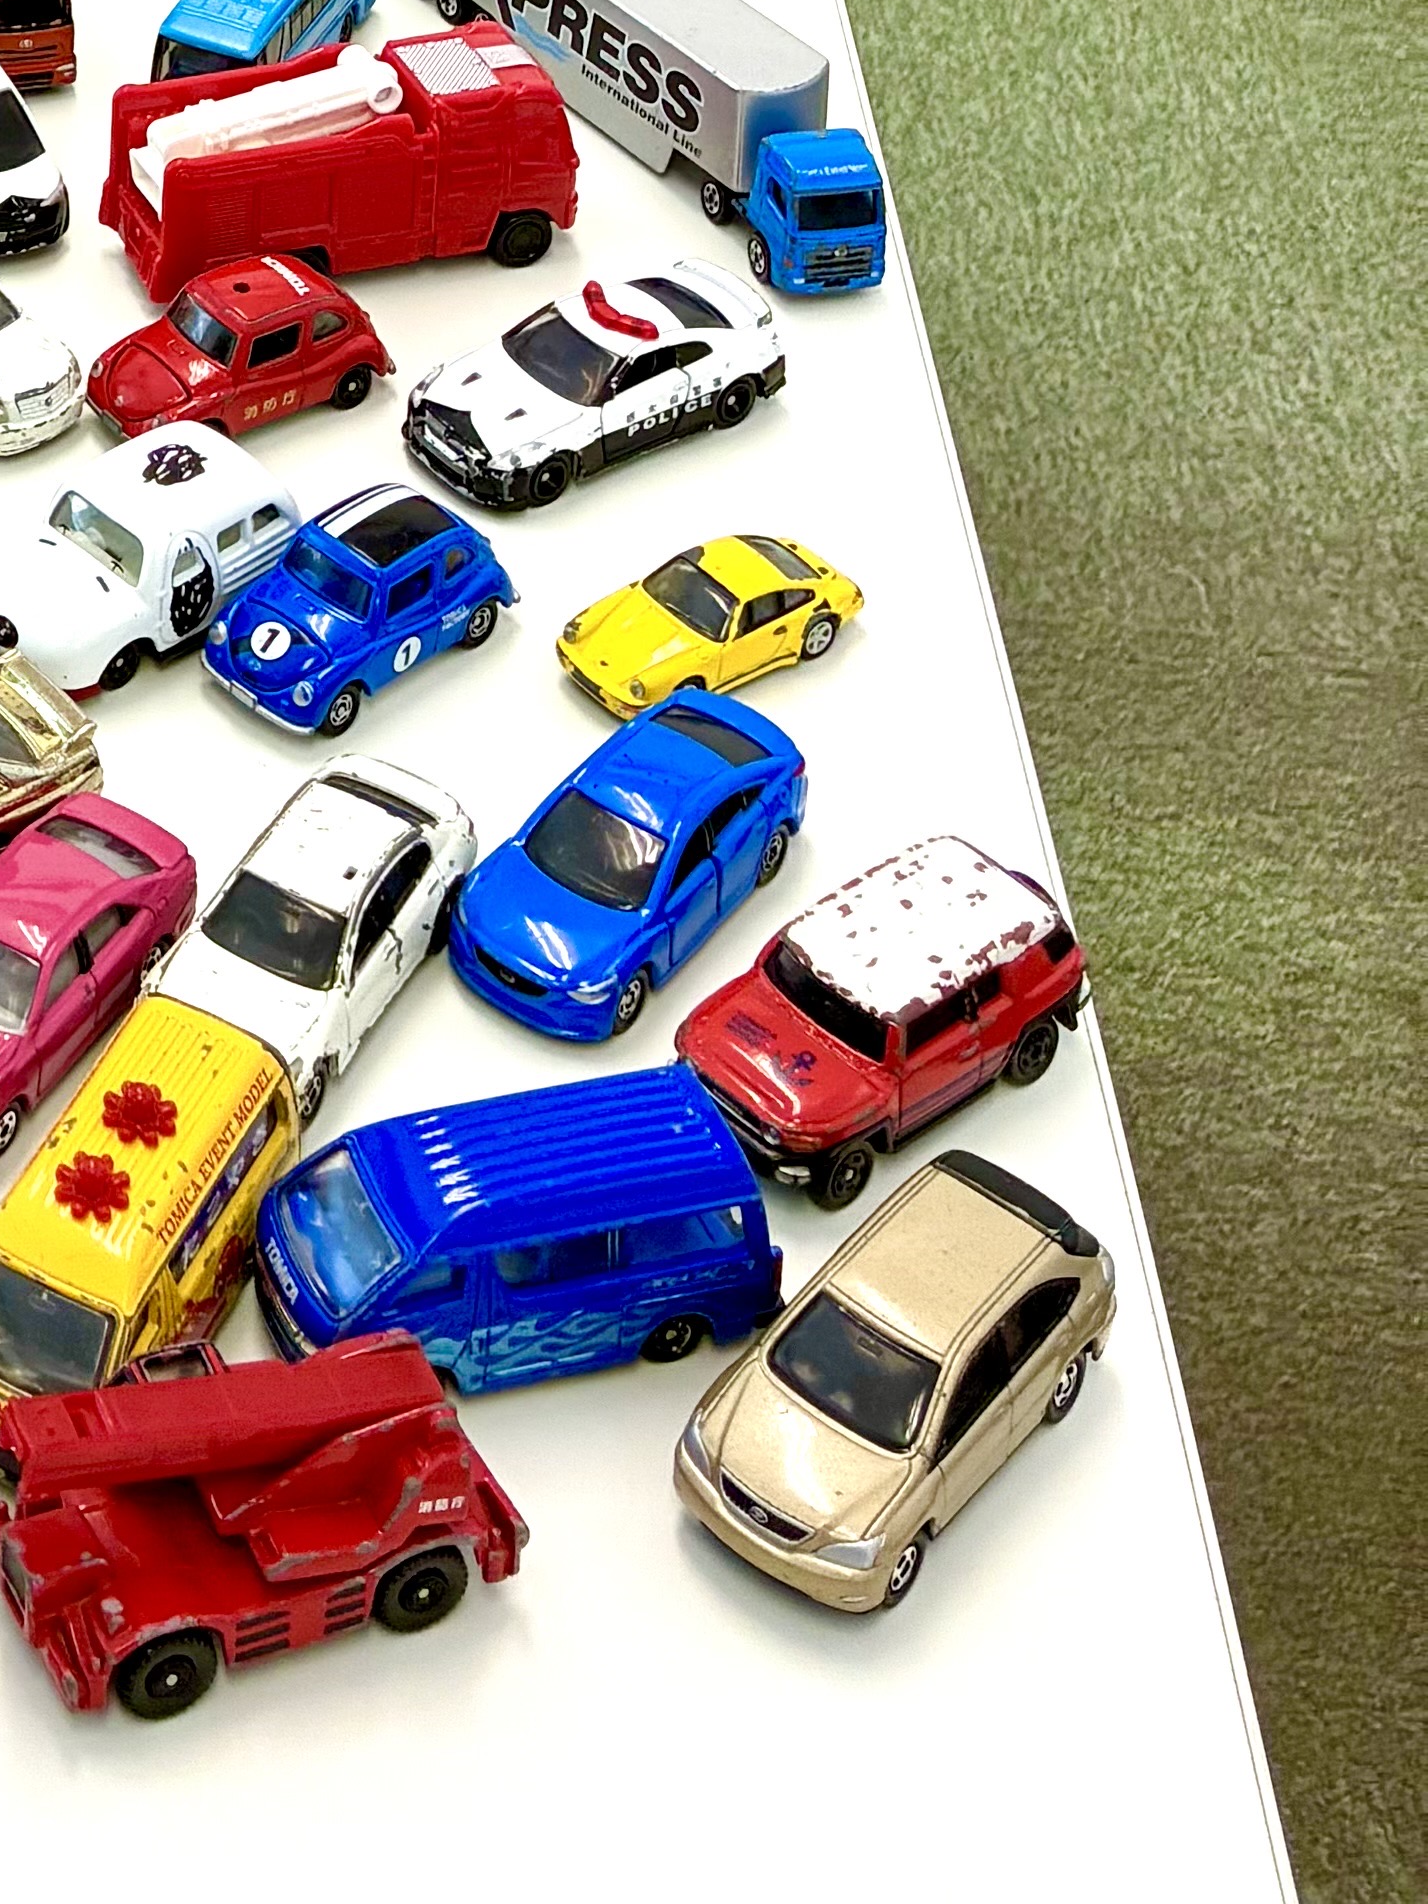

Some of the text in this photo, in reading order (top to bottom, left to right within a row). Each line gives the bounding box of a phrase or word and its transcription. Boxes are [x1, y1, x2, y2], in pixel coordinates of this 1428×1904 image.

[580, 63, 703, 160] International Line
[627, 393, 712, 438] POLICE
[263, 628, 280, 656] 1
[401, 643, 414, 667] 1
[155, 1067, 275, 1246] TOMICA EVENT MODEL
[265, 1236, 299, 1306] TOMICA
